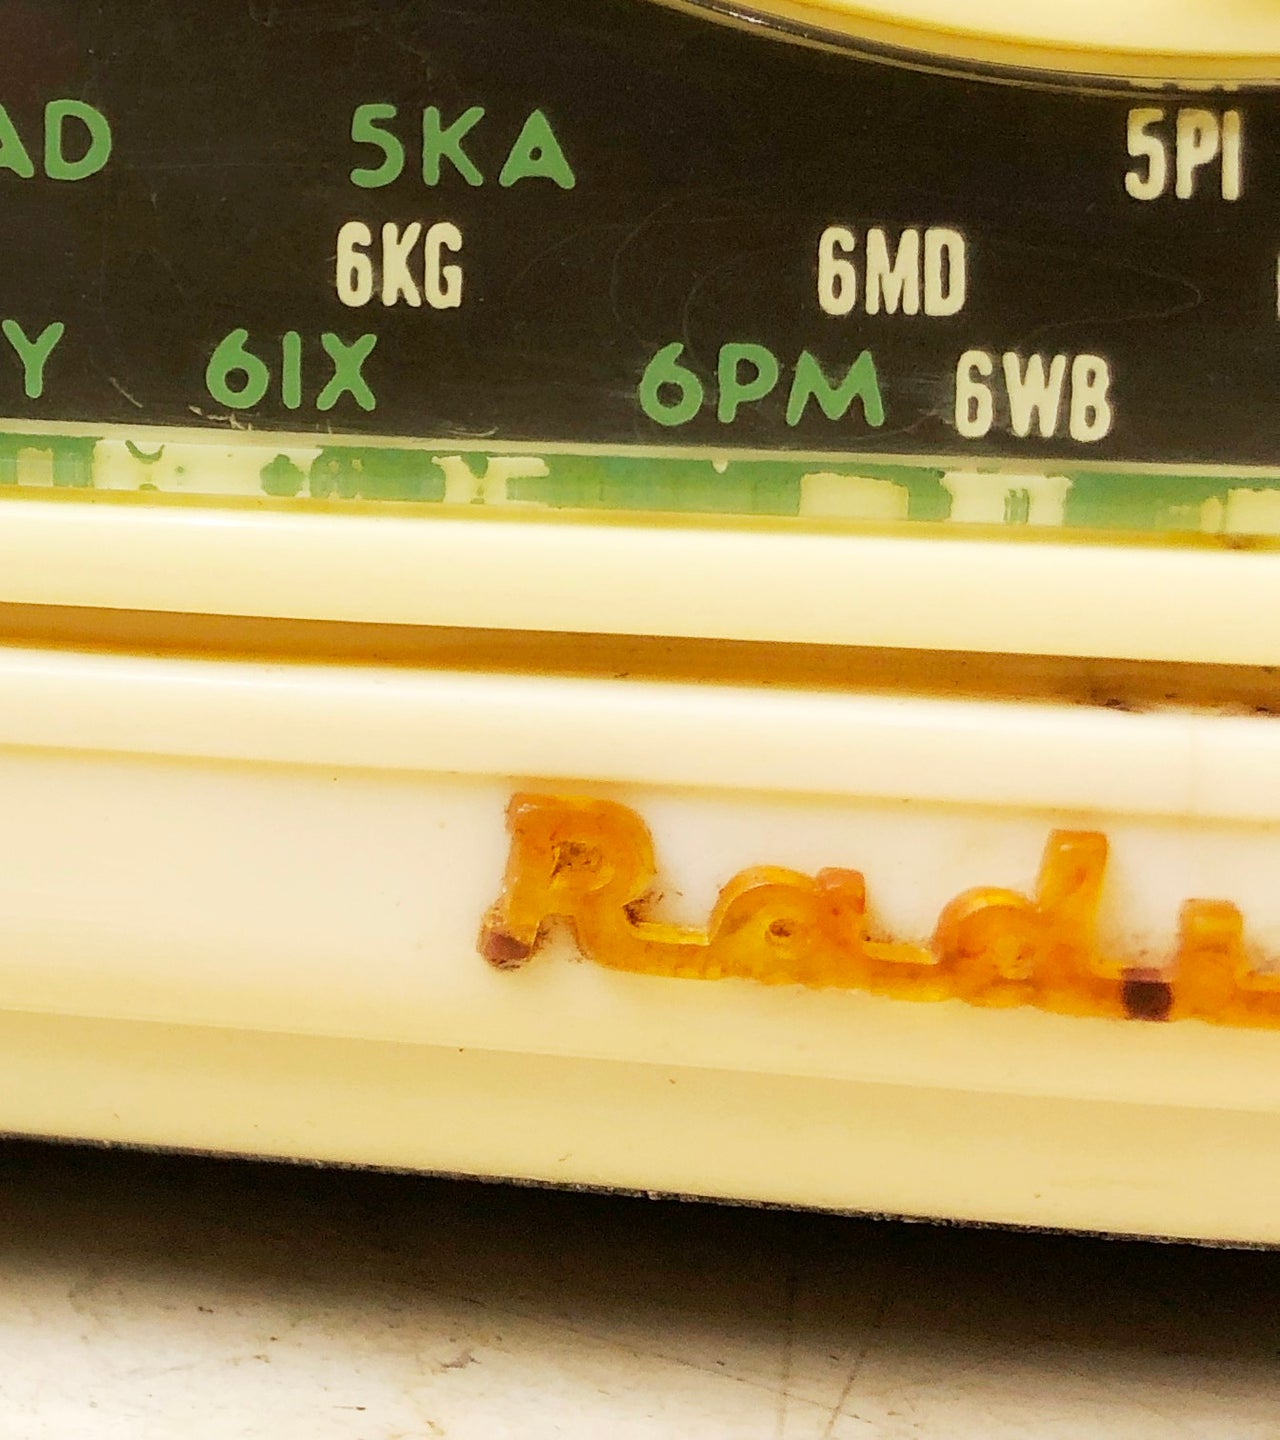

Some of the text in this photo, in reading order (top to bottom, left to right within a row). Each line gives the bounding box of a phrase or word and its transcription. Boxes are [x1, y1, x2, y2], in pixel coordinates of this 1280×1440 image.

[350, 103, 576, 190] 5KA
[1124, 107, 1243, 202] 5PI
[335, 220, 464, 310] 6KG
[817, 224, 969, 318] 6MD
[205, 328, 378, 412] 6IX
[638, 342, 886, 428] 6PM
[954, 349, 1114, 444] 6WB
